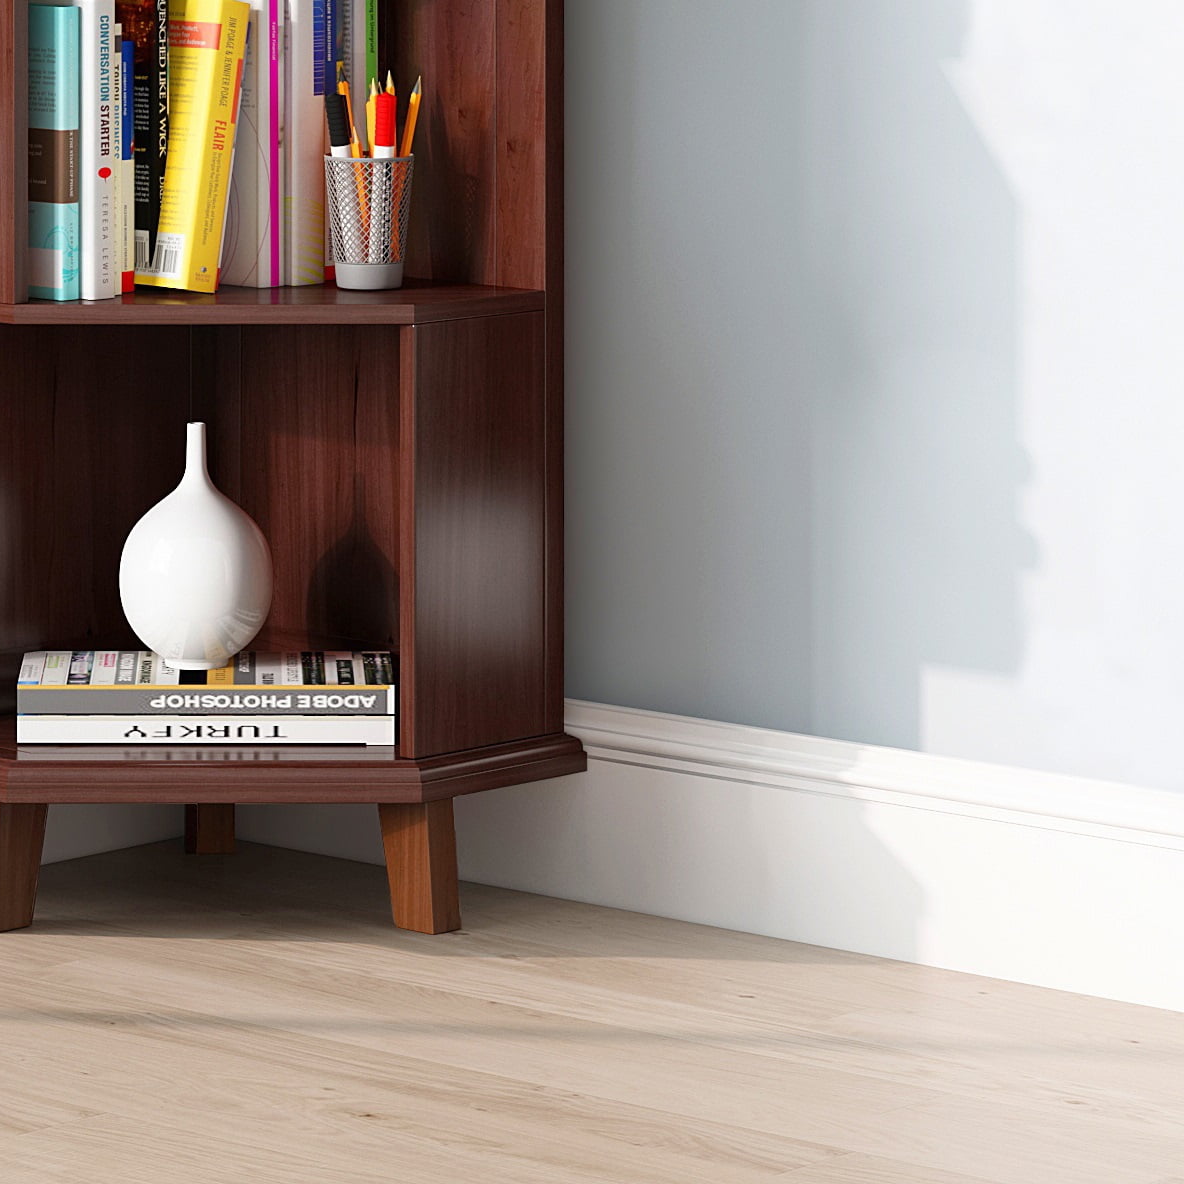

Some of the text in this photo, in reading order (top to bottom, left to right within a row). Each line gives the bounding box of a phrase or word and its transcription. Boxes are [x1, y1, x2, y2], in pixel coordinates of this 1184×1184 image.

[228, 17, 237, 28] JIM
[226, 28, 236, 49] POAGE
[222, 56, 233, 85] JENNIFER
[100, 15, 110, 156] CONVERSATION STARTER
[219, 86, 229, 107] POAGE
[159, 103, 166, 114] A
[159, 117, 167, 157] WICK
[212, 119, 227, 151] FLAIR
[150, 695, 376, 708] ADOBE PHOTOSHOP
